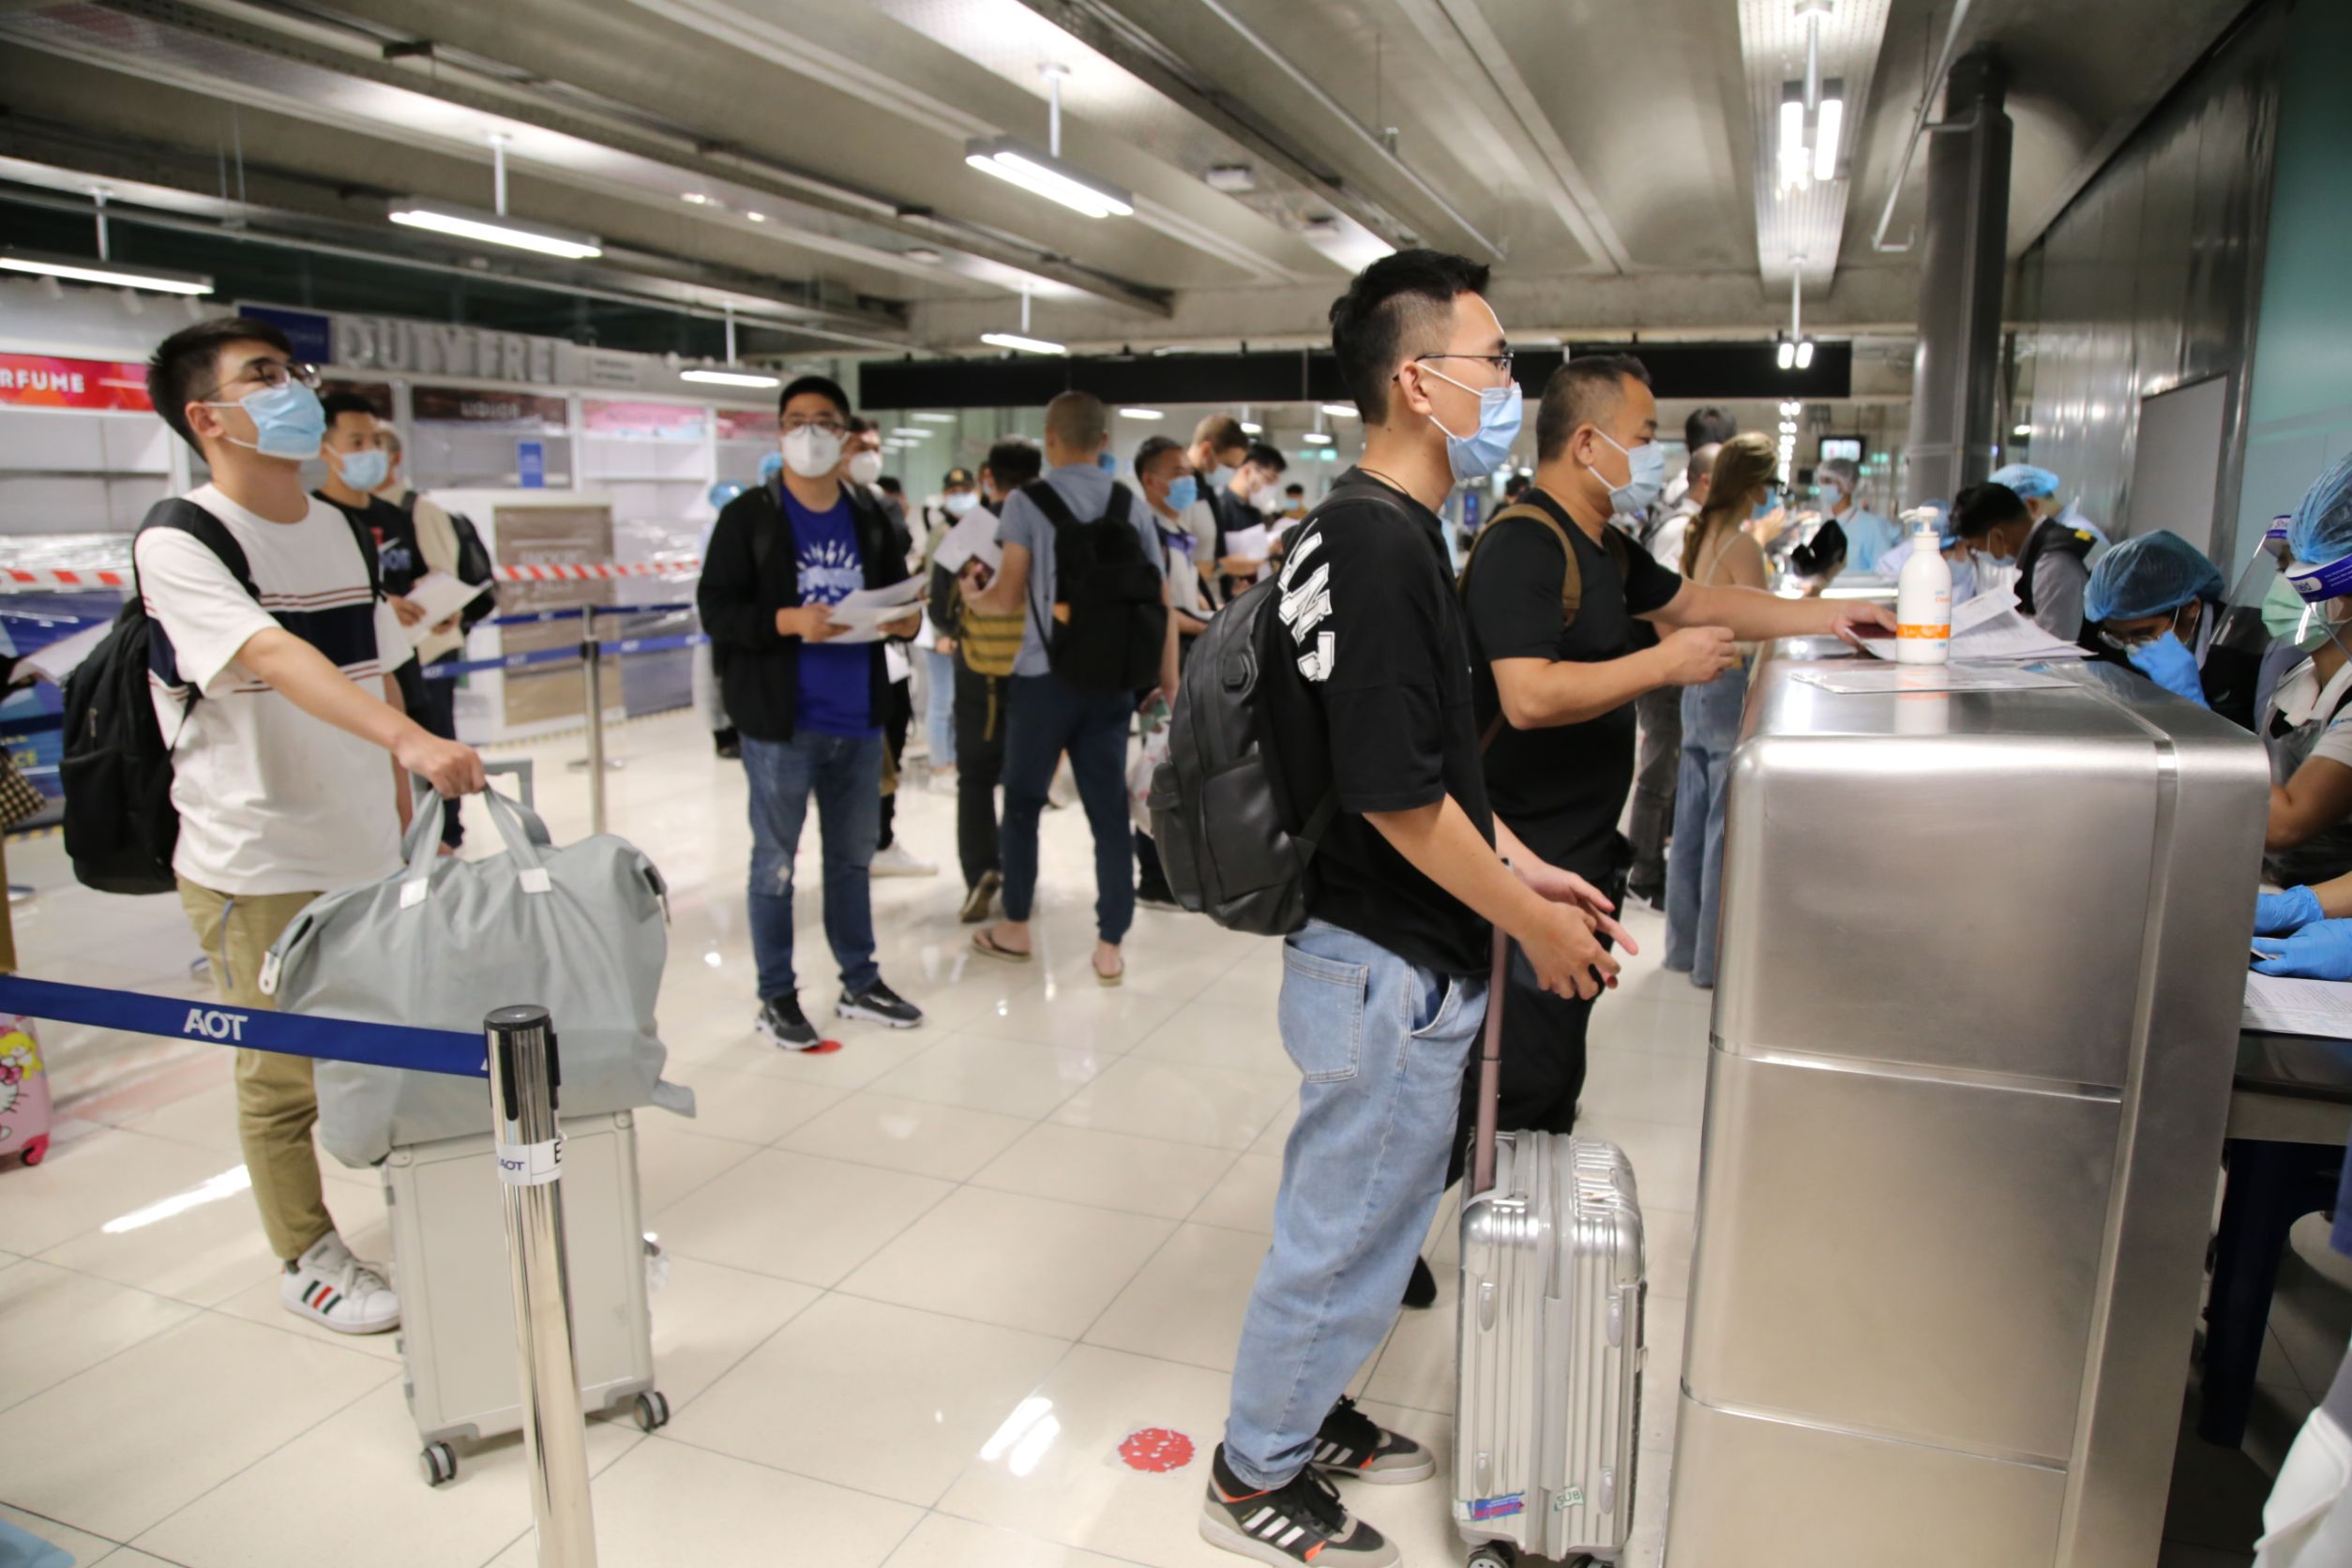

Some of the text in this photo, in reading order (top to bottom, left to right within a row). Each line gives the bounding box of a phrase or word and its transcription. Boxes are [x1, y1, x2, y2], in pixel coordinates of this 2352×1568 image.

[338, 314, 475, 375] DUTY
[184, 1008, 249, 1041] AOT
[499, 1158, 525, 1171] AOT
